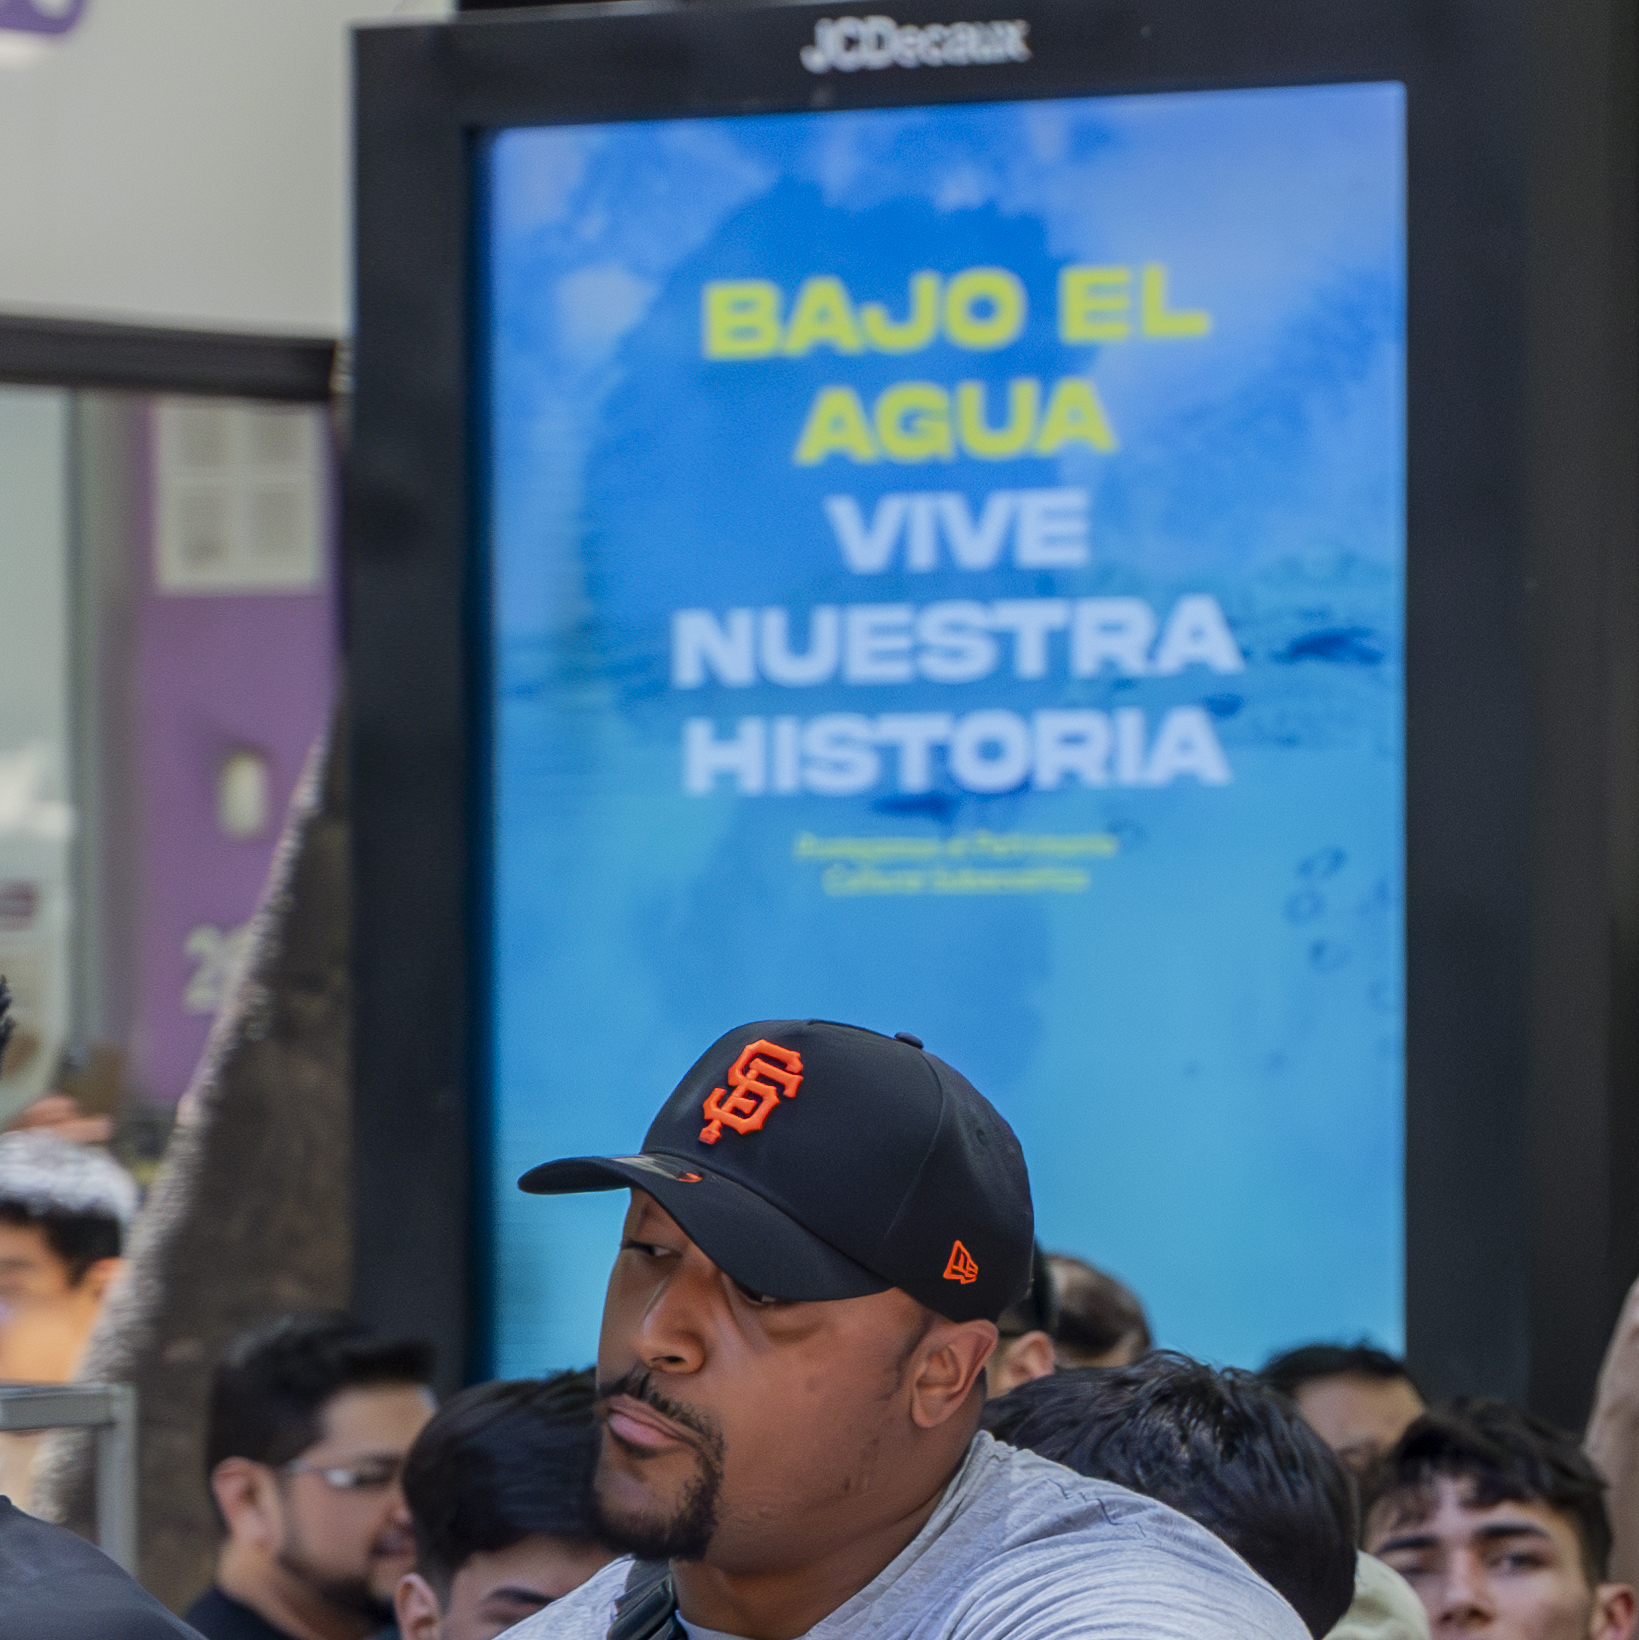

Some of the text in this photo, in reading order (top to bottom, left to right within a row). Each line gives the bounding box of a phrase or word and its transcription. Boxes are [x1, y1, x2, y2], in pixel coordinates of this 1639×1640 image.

[801, 16, 1032, 74] JCDecaux
[701, 264, 1210, 360] BAJO EL
[795, 377, 1117, 465] AGUA
[824, 487, 1091, 575] VIVE
[670, 594, 1245, 690] NUESTRA
[681, 705, 1234, 797] HISTORIA
